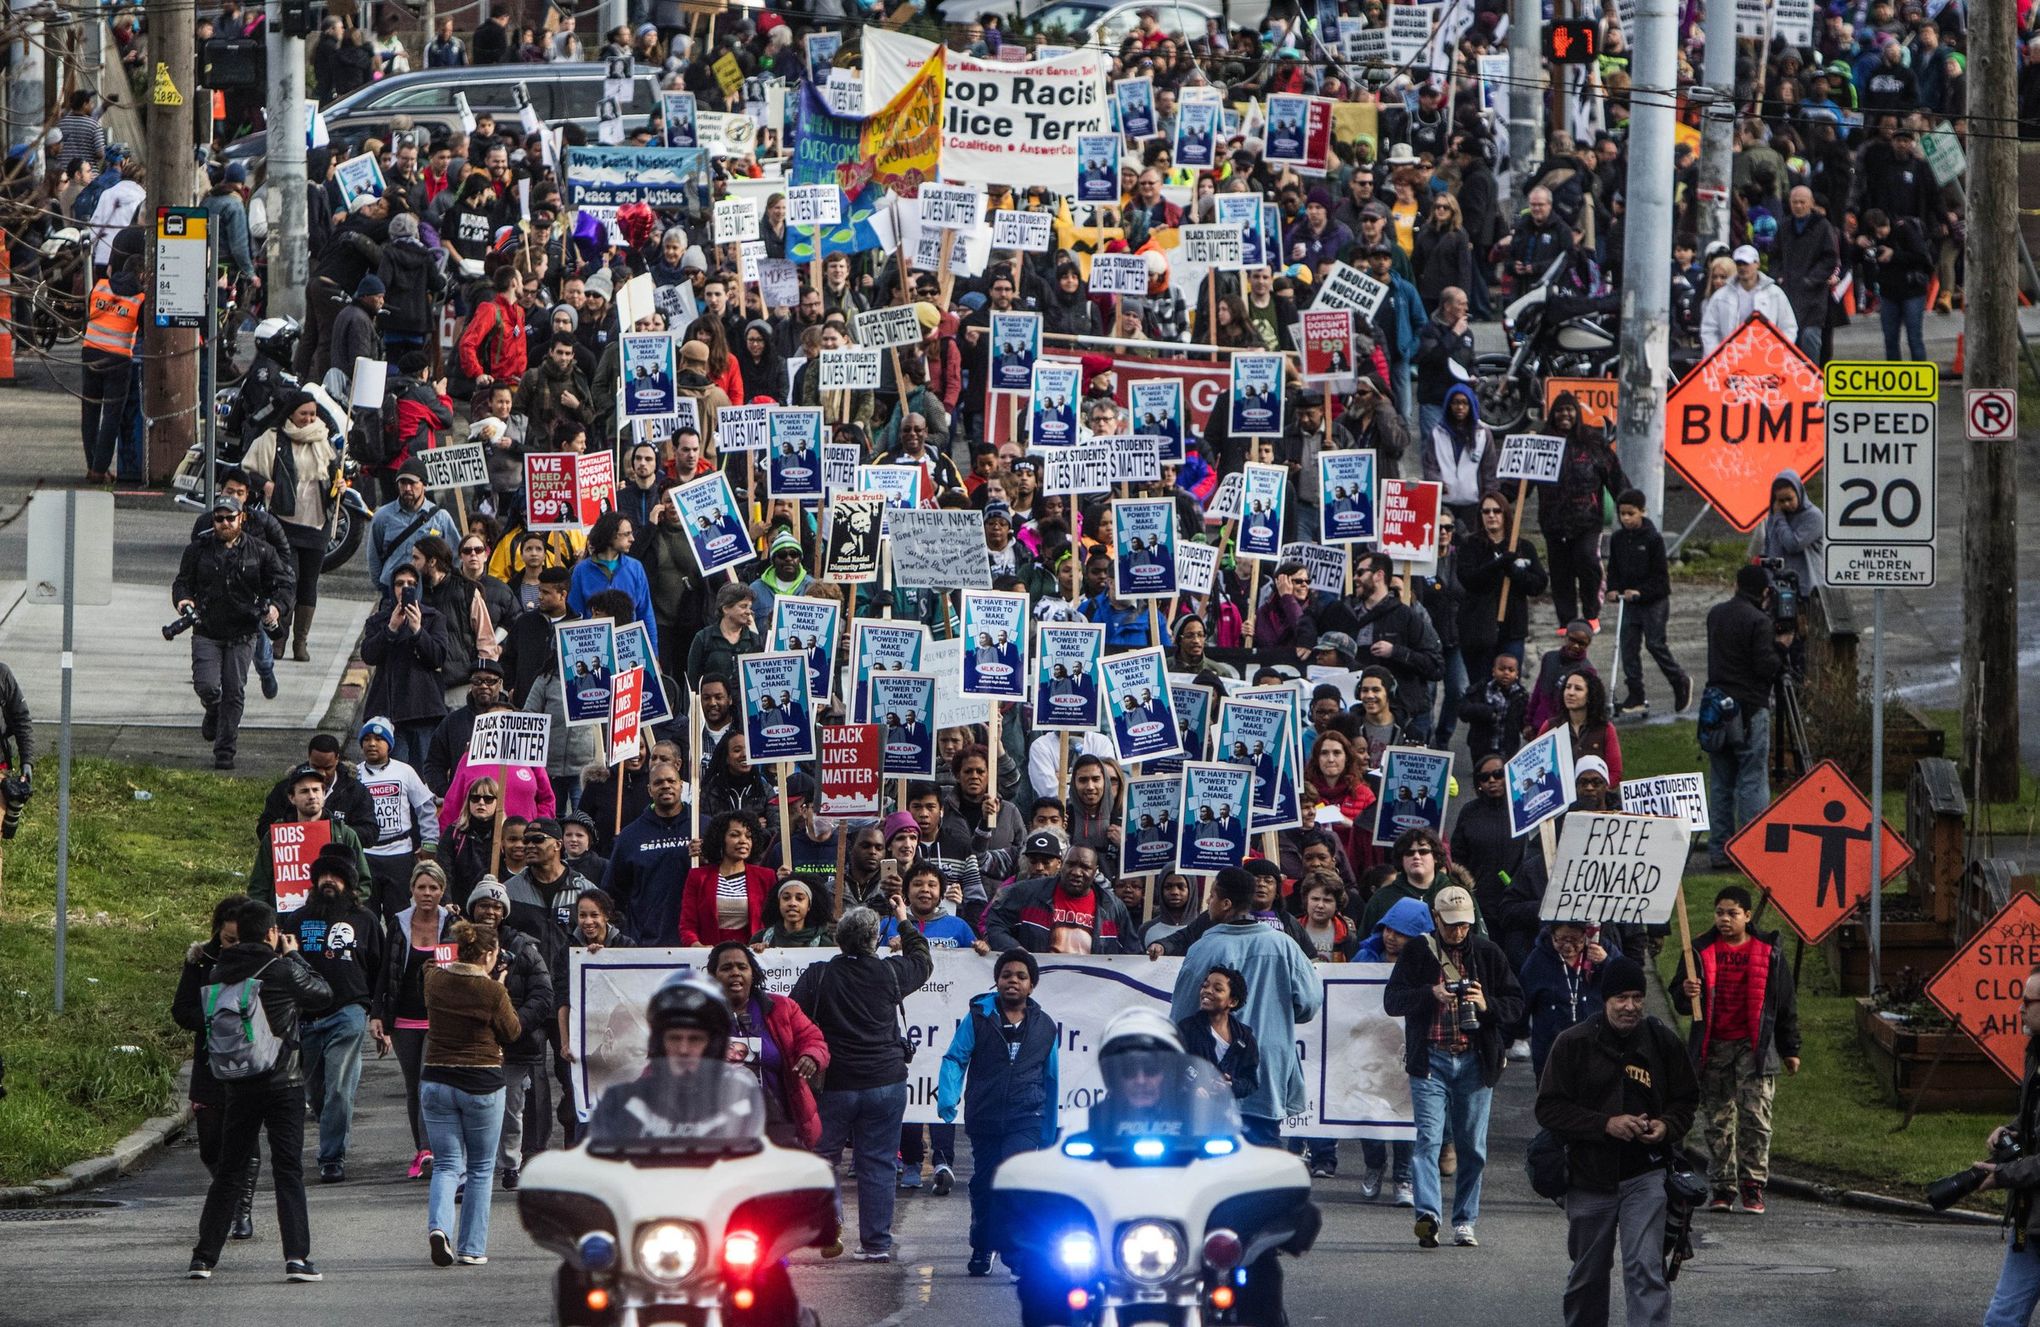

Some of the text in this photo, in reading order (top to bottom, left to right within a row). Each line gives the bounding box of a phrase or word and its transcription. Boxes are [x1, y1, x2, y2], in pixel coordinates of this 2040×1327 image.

[945, 81, 998, 106] top
[801, 138, 860, 164] OVERCOM
[602, 152, 632, 168] Seattle
[626, 170, 637, 182] for
[574, 187, 683, 204] Peace and Justice
[1094, 257, 1112, 268] BLACK
[1092, 268, 1145, 290] LIVES MATTER
[1338, 268, 1381, 296] ABOLISH
[1330, 281, 1374, 310] NUCLEAR
[858, 314, 880, 327] BLACK
[863, 321, 919, 348] LIVES MATTER
[823, 352, 843, 363] BLACK
[822, 364, 878, 384] LIVES MATTER
[1834, 370, 1928, 391] SCHOOL
[1681, 402, 1824, 445] BUMP
[1833, 412, 1929, 434] SPEED
[1505, 438, 1524, 449] BLACK
[421, 450, 443, 462] BLACK
[1048, 450, 1068, 464] BLACK
[1843, 443, 1917, 464] LIMIT
[451, 458, 484, 483] MATTER
[531, 458, 562, 472] WE
[579, 463, 610, 476] DOESN'T
[1499, 450, 1557, 477] LIVES MATTER
[532, 472, 572, 481] NEED A
[579, 473, 612, 487] WORK
[1047, 462, 1109, 491] LIVES MATTER
[532, 482, 567, 490] PARTY
[1388, 482, 1402, 495] NO
[533, 490, 572, 499] OF THE
[1386, 496, 1408, 508] NEW
[1839, 478, 1921, 528] 20
[888, 513, 983, 526] SAY THEIR NAMES
[1386, 510, 1416, 523] YOUTH
[1384, 523, 1403, 535] JAIL
[1863, 549, 1898, 558] WHEN
[1849, 560, 1912, 569] CHILDREN
[1835, 571, 1925, 581] ARE PRESENT
[616, 674, 635, 692] BLACK
[761, 680, 791, 688] CHANGE
[615, 693, 631, 712] LIVES
[476, 716, 547, 732] BLACK STUDENTS'
[614, 710, 636, 734] MATTER
[823, 727, 863, 744] BLACK
[471, 732, 544, 761] LIVES MATTER
[822, 749, 858, 764] LIVES
[822, 769, 872, 784] MATTER
[370, 785, 395, 795] ANGER
[1623, 778, 1699, 801] BLACK STUDENTS'
[376, 798, 399, 806] CATED
[1662, 794, 1704, 824] MATTER
[377, 807, 399, 817] ACK
[379, 818, 399, 829] UTH
[274, 827, 305, 844] JOBS
[1584, 818, 1653, 856] FREE
[275, 846, 300, 863] NOT
[276, 864, 310, 882] JAILS
[1561, 859, 1661, 894] LEONARD
[491, 889, 502, 900] W
[1556, 893, 1652, 924] PELTIER
[436, 948, 451, 961] NO
[1978, 945, 2040, 965] STRE
[1976, 979, 2023, 1000] CLO
[1625, 1064, 1652, 1089] TTLE
[1117, 1121, 1182, 1136] POLICE
